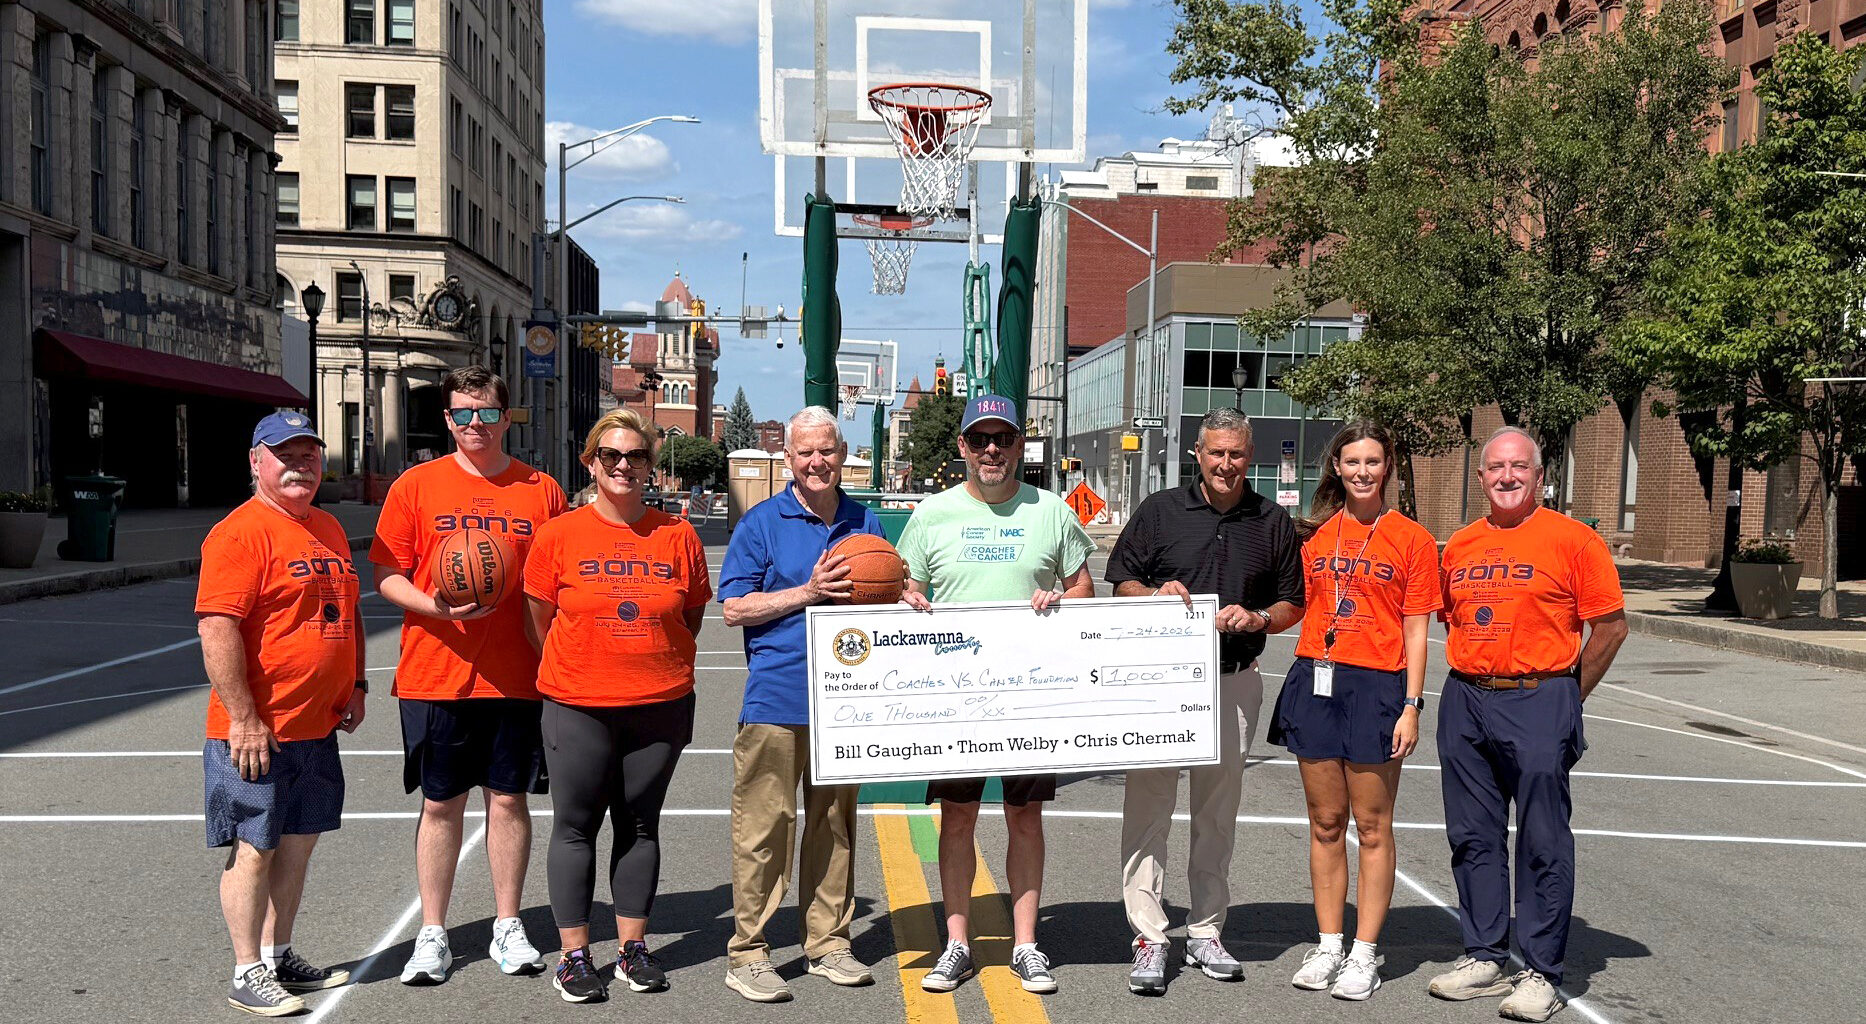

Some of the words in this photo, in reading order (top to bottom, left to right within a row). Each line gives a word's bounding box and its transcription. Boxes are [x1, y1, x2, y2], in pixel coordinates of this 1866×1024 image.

[977, 400, 1007, 415] 18411
[74, 491, 99, 499] WM
[454, 507, 512, 516] 2026
[1000, 528, 1025, 537] NABC
[597, 552, 653, 560] 2026
[977, 553, 1016, 561] CANCER
[452, 551, 469, 592] NCAA
[477, 540, 497, 594] Wilson
[1460, 581, 1513, 590] BASKETBALL
[1185, 611, 1205, 619] 1211
[1080, 631, 1102, 640] Date
[1110, 626, 1193, 640] 7-24-2026
[872, 630, 964, 646] Lackawanna
[934, 636, 982, 655] County
[825, 671, 840, 680] Pay
[842, 671, 852, 679] to
[1090, 669, 1099, 684] $
[825, 684, 840, 692] the
[842, 683, 867, 691] Order
[869, 682, 879, 690] of
[1180, 703, 1211, 712] Dollars
[835, 745, 861, 759] Bill
[867, 743, 943, 760] Gaughan
[957, 740, 1003, 754] Thom
[1007, 737, 1059, 753] Welby
[1074, 734, 1117, 748] Chris
[1122, 730, 1196, 746] Chermak
